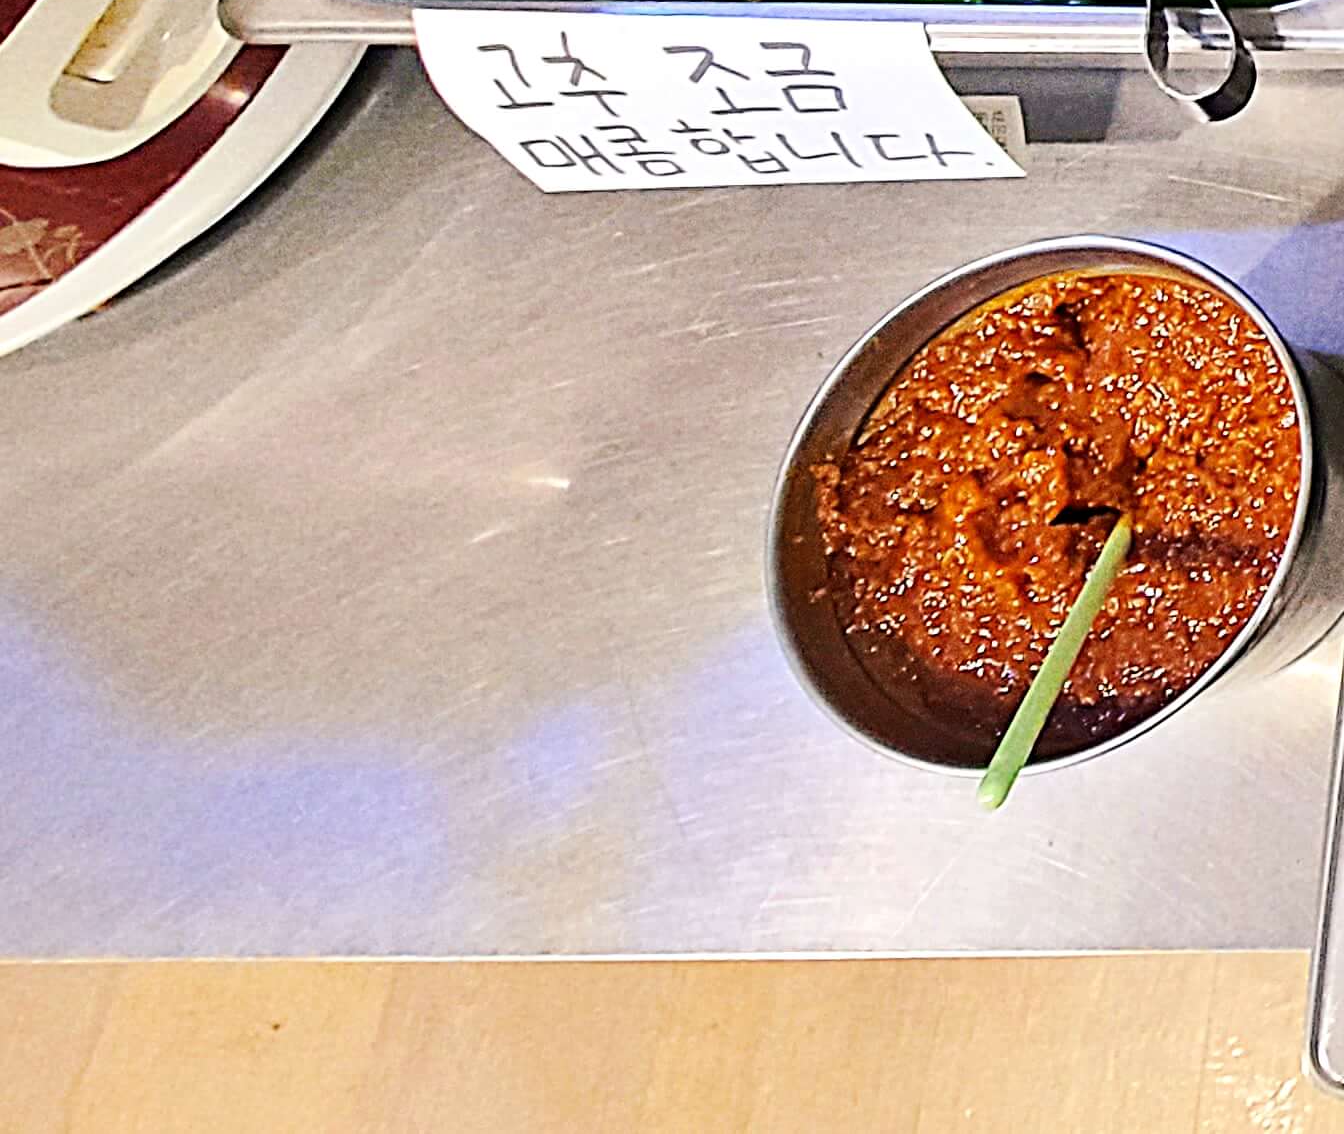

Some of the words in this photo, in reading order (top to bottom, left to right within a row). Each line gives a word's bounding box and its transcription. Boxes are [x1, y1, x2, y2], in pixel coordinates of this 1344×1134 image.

[478, 32, 627, 116] 고추
[664, 41, 847, 115] 조금
[519, 119, 995, 176] 매콤합니다.
